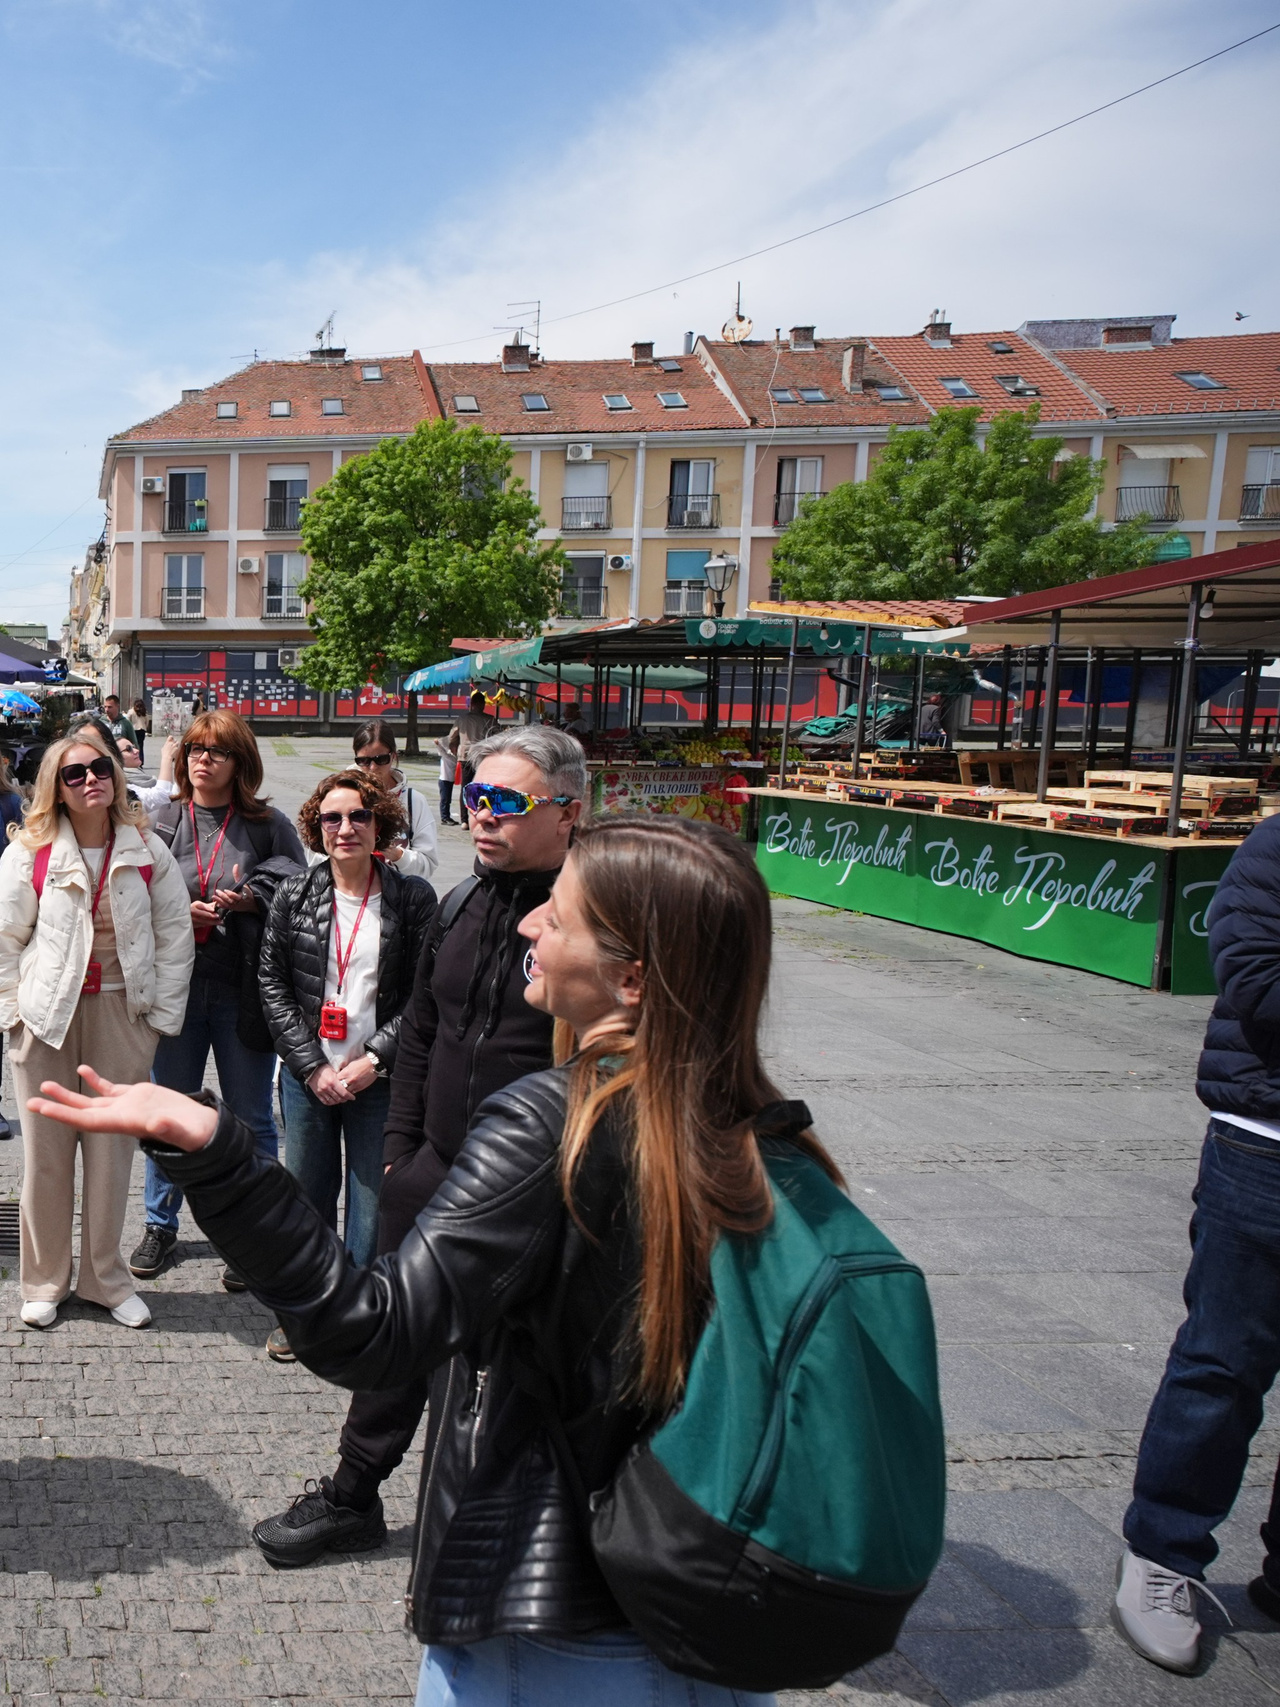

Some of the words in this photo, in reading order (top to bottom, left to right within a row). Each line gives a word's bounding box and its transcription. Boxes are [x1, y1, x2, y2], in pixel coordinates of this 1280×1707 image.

[625, 771, 651, 782] УВЕК
[652, 771, 687, 782] СВЕЖЕ
[643, 783, 699, 794] ПАВЛОВИЋ
[819, 817, 913, 886] Перовић
[1003, 845, 1157, 931] Перовић
